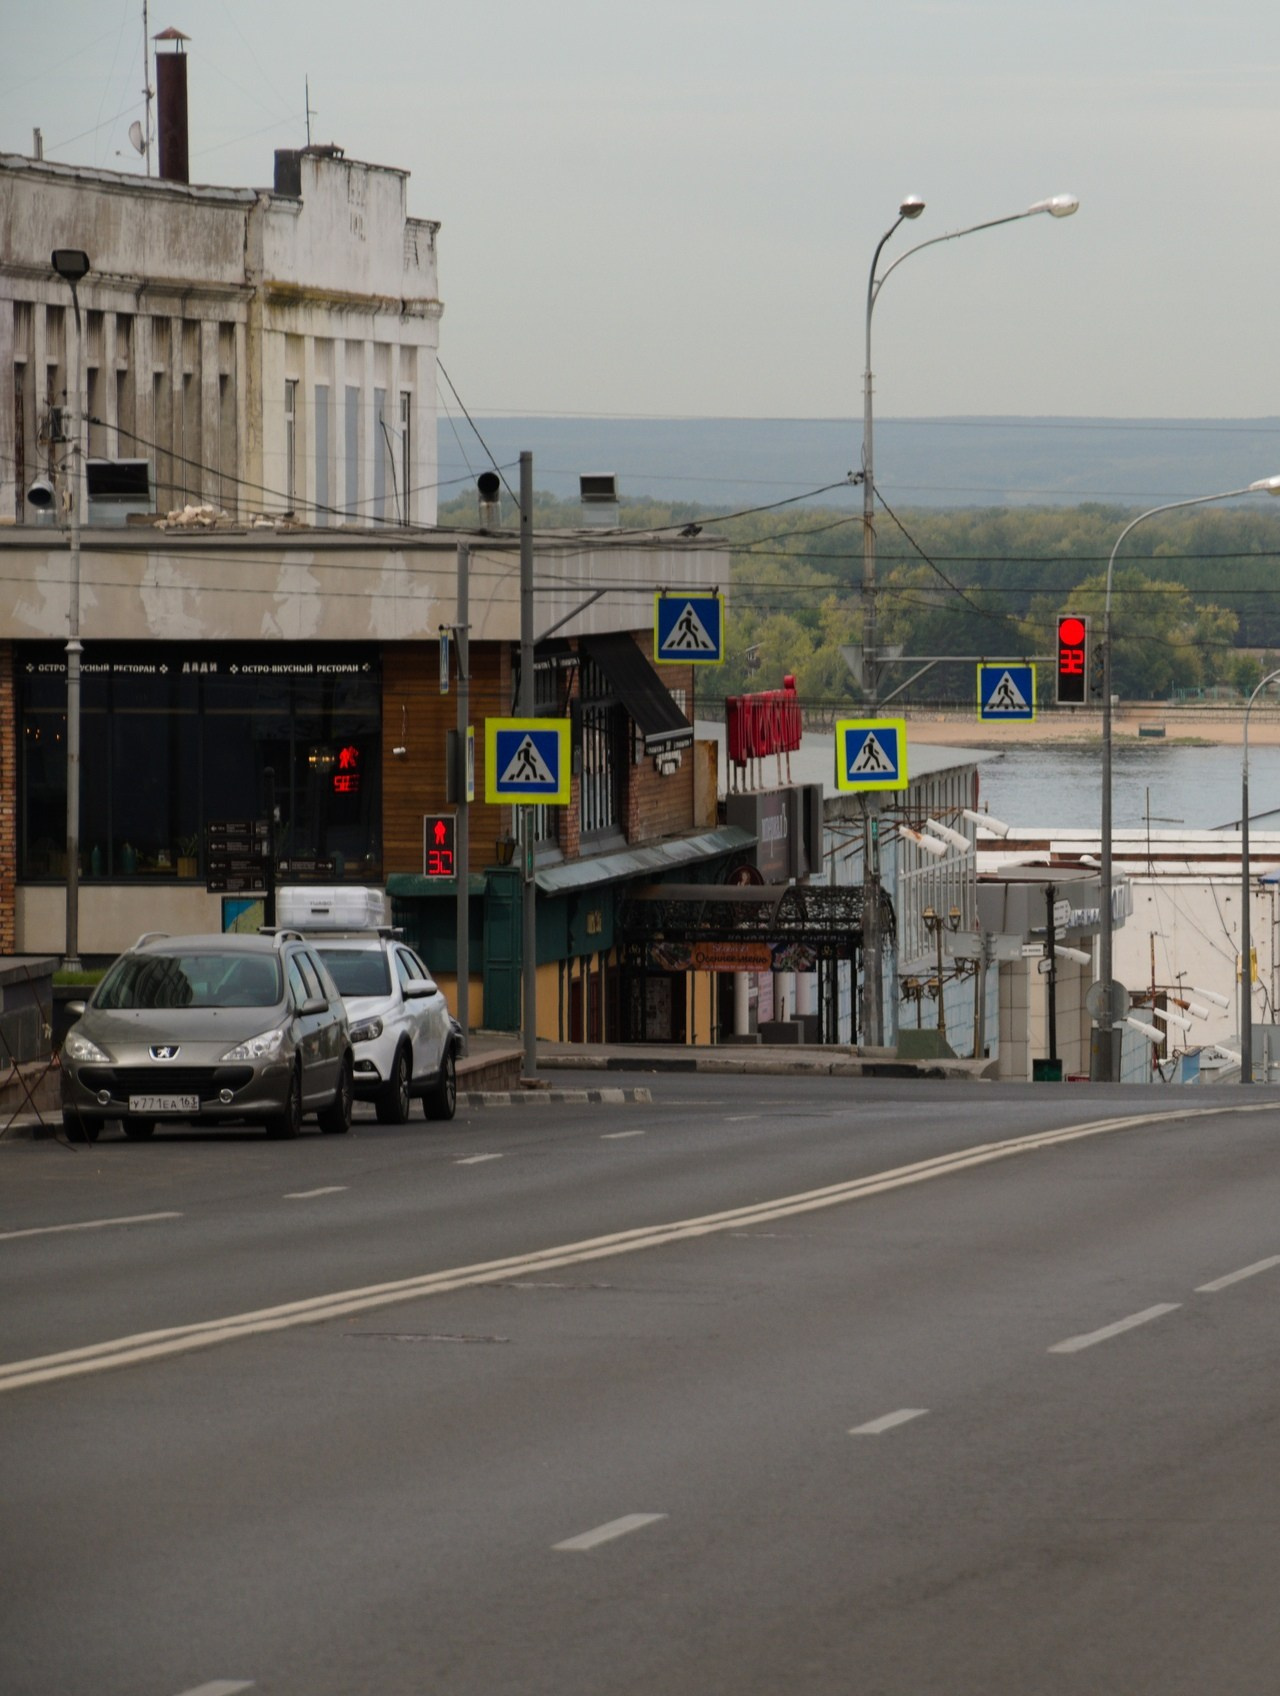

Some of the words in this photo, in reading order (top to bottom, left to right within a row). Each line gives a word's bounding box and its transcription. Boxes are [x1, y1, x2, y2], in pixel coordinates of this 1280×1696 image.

[38, 663, 110, 673] ОСТРО-УСНЫЙ
[113, 664, 156, 673] РЕСТОРАН
[182, 661, 218, 674] ДАДИ
[241, 663, 313, 673] ОСТРО-ВКУСНЫЙ
[316, 664, 359, 673] РЕСТОРАН
[1060, 649, 1084, 674] 32
[428, 850, 453, 874] 32
